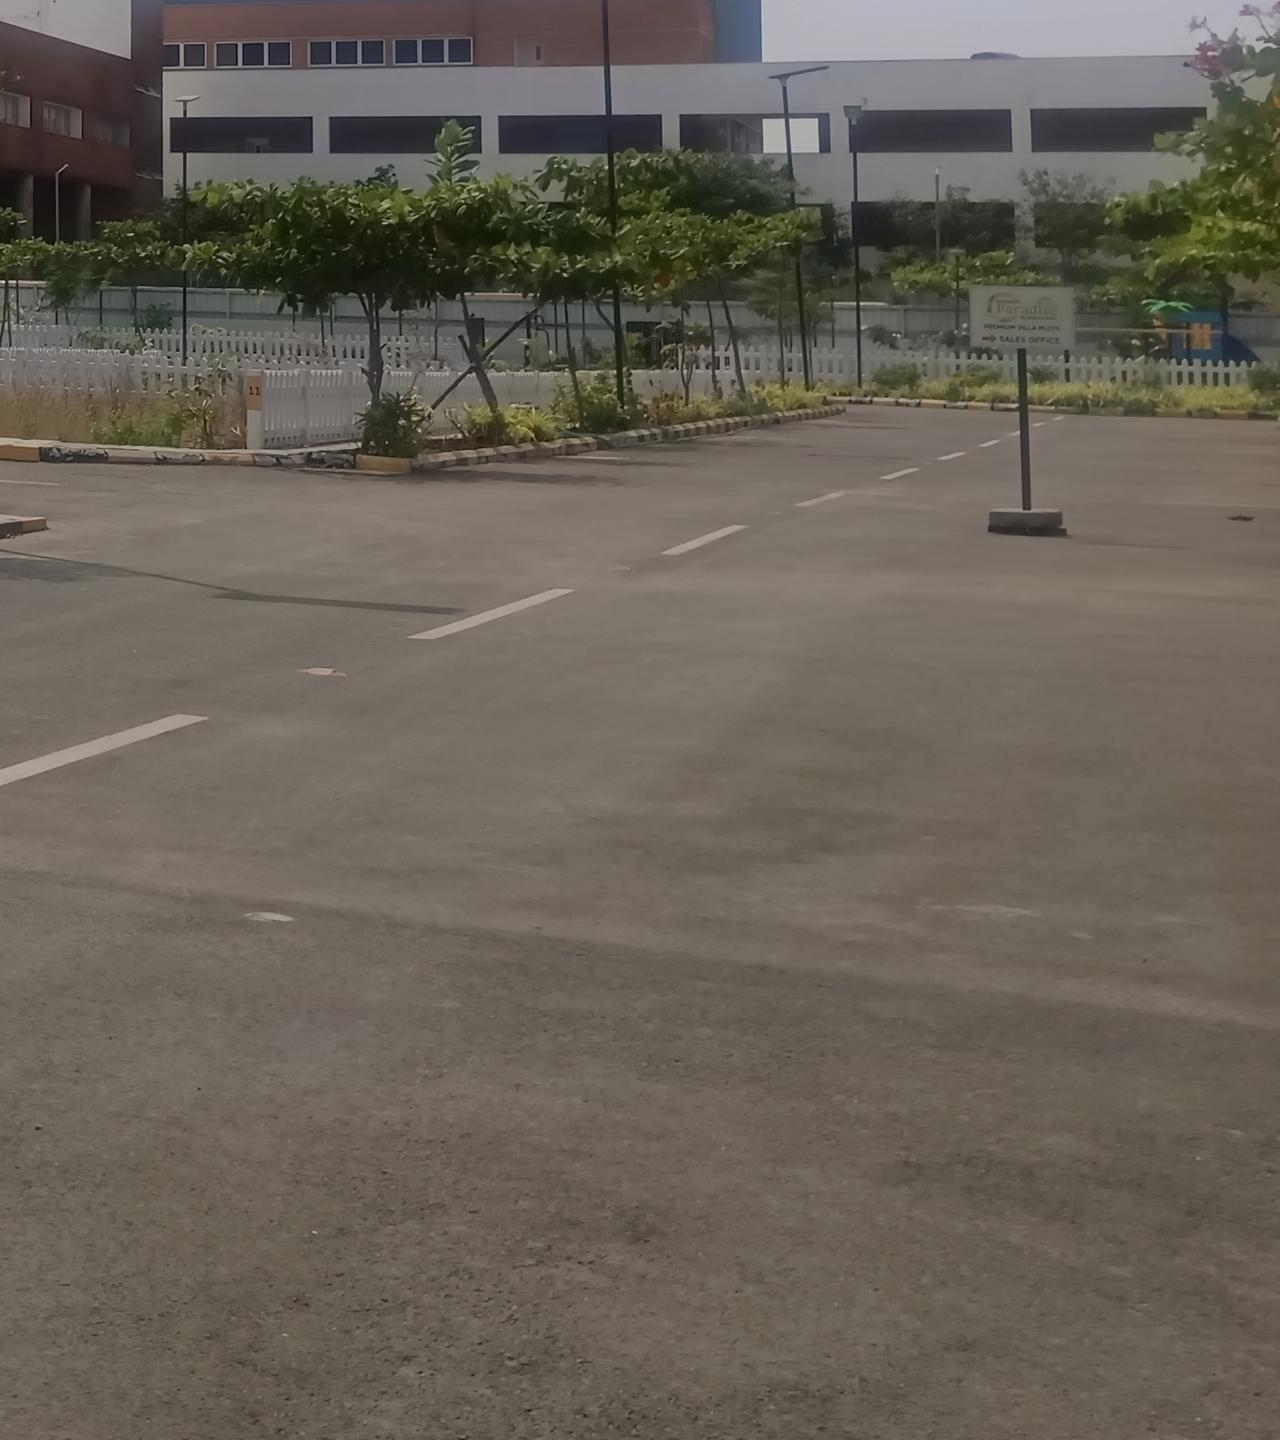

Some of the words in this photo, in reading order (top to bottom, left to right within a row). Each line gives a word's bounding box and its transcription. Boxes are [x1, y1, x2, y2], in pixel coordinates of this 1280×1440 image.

[999, 335, 1026, 343] SALES
[1028, 336, 1061, 344] OFFICE
[249, 386, 260, 396] 11
